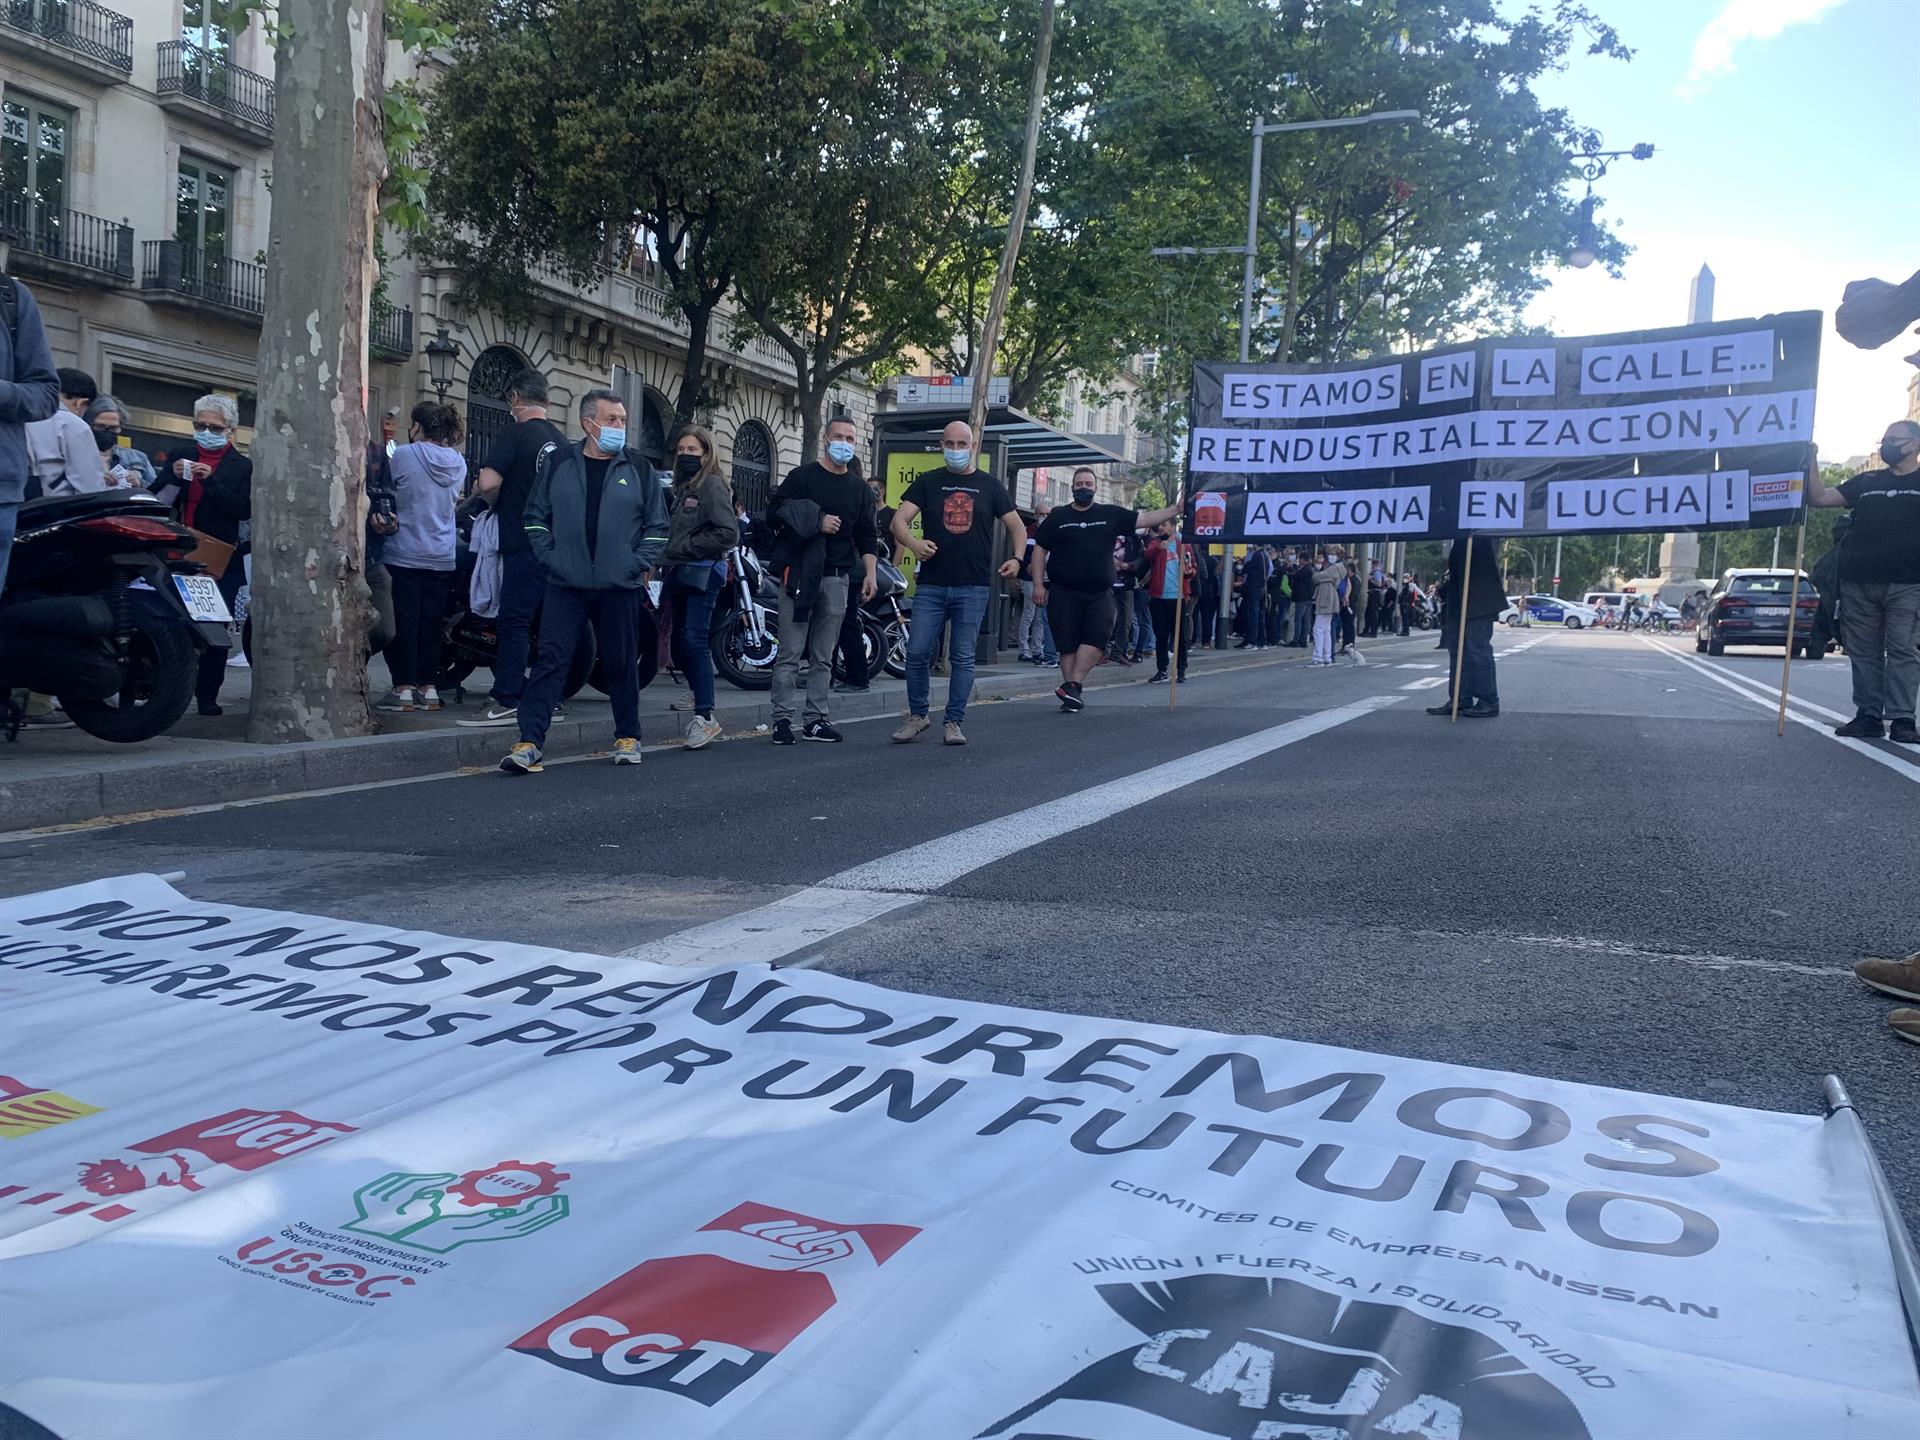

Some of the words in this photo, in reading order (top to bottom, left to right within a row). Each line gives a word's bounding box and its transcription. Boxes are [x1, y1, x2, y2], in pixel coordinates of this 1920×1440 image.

[1230, 374, 1395, 409] ESTAMOS
[1427, 361, 1469, 393] EN
[1502, 358, 1550, 385] LA
[1588, 345, 1766, 384] CALLE...
[1250, 496, 1424, 525] ACCIONA
[1467, 491, 1517, 519] EN
[1755, 482, 1787, 493] CCOO
[1197, 526, 1221, 536] CGT
[185, 579, 215, 595] 9997
[192, 596, 216, 612] HDF
[18, 900, 231, 941] NO
[189, 928, 495, 984] NOS
[464, 965, 1720, 1177] RENDIREMOS
[198, 1114, 336, 1156] UGT
[467, 1020, 732, 1084] POR
[742, 1060, 967, 1122] UN
[976, 1097, 1719, 1257] FUTURO
[484, 1174, 536, 1191] SIGEN
[1110, 1179, 1259, 1223] COMITÉS
[1269, 1216, 1318, 1232] DE
[237, 1236, 416, 1298] USOC
[280, 1229, 317, 1247] GRUPO
[318, 1241, 335, 1252] DE
[336, 1244, 389, 1265] EMPRESAS
[388, 1261, 433, 1275] NISSAN
[295, 1221, 350, 1242] SINDICATO
[352, 1237, 431, 1265] INDEPENDIENTE
[432, 1260, 450, 1269] DE
[241, 1267, 278, 1280] SINDICAL
[279, 1278, 312, 1291] OBRERA
[325, 1291, 375, 1307] CATALUNYA
[1073, 1254, 1184, 1274] UNIÓN
[1216, 1253, 1358, 1289] FUERZA
[1392, 1285, 1617, 1389] SOLIDARIDAD
[547, 1315, 754, 1386] CGT
[1133, 1328, 1463, 1440] CAJA
